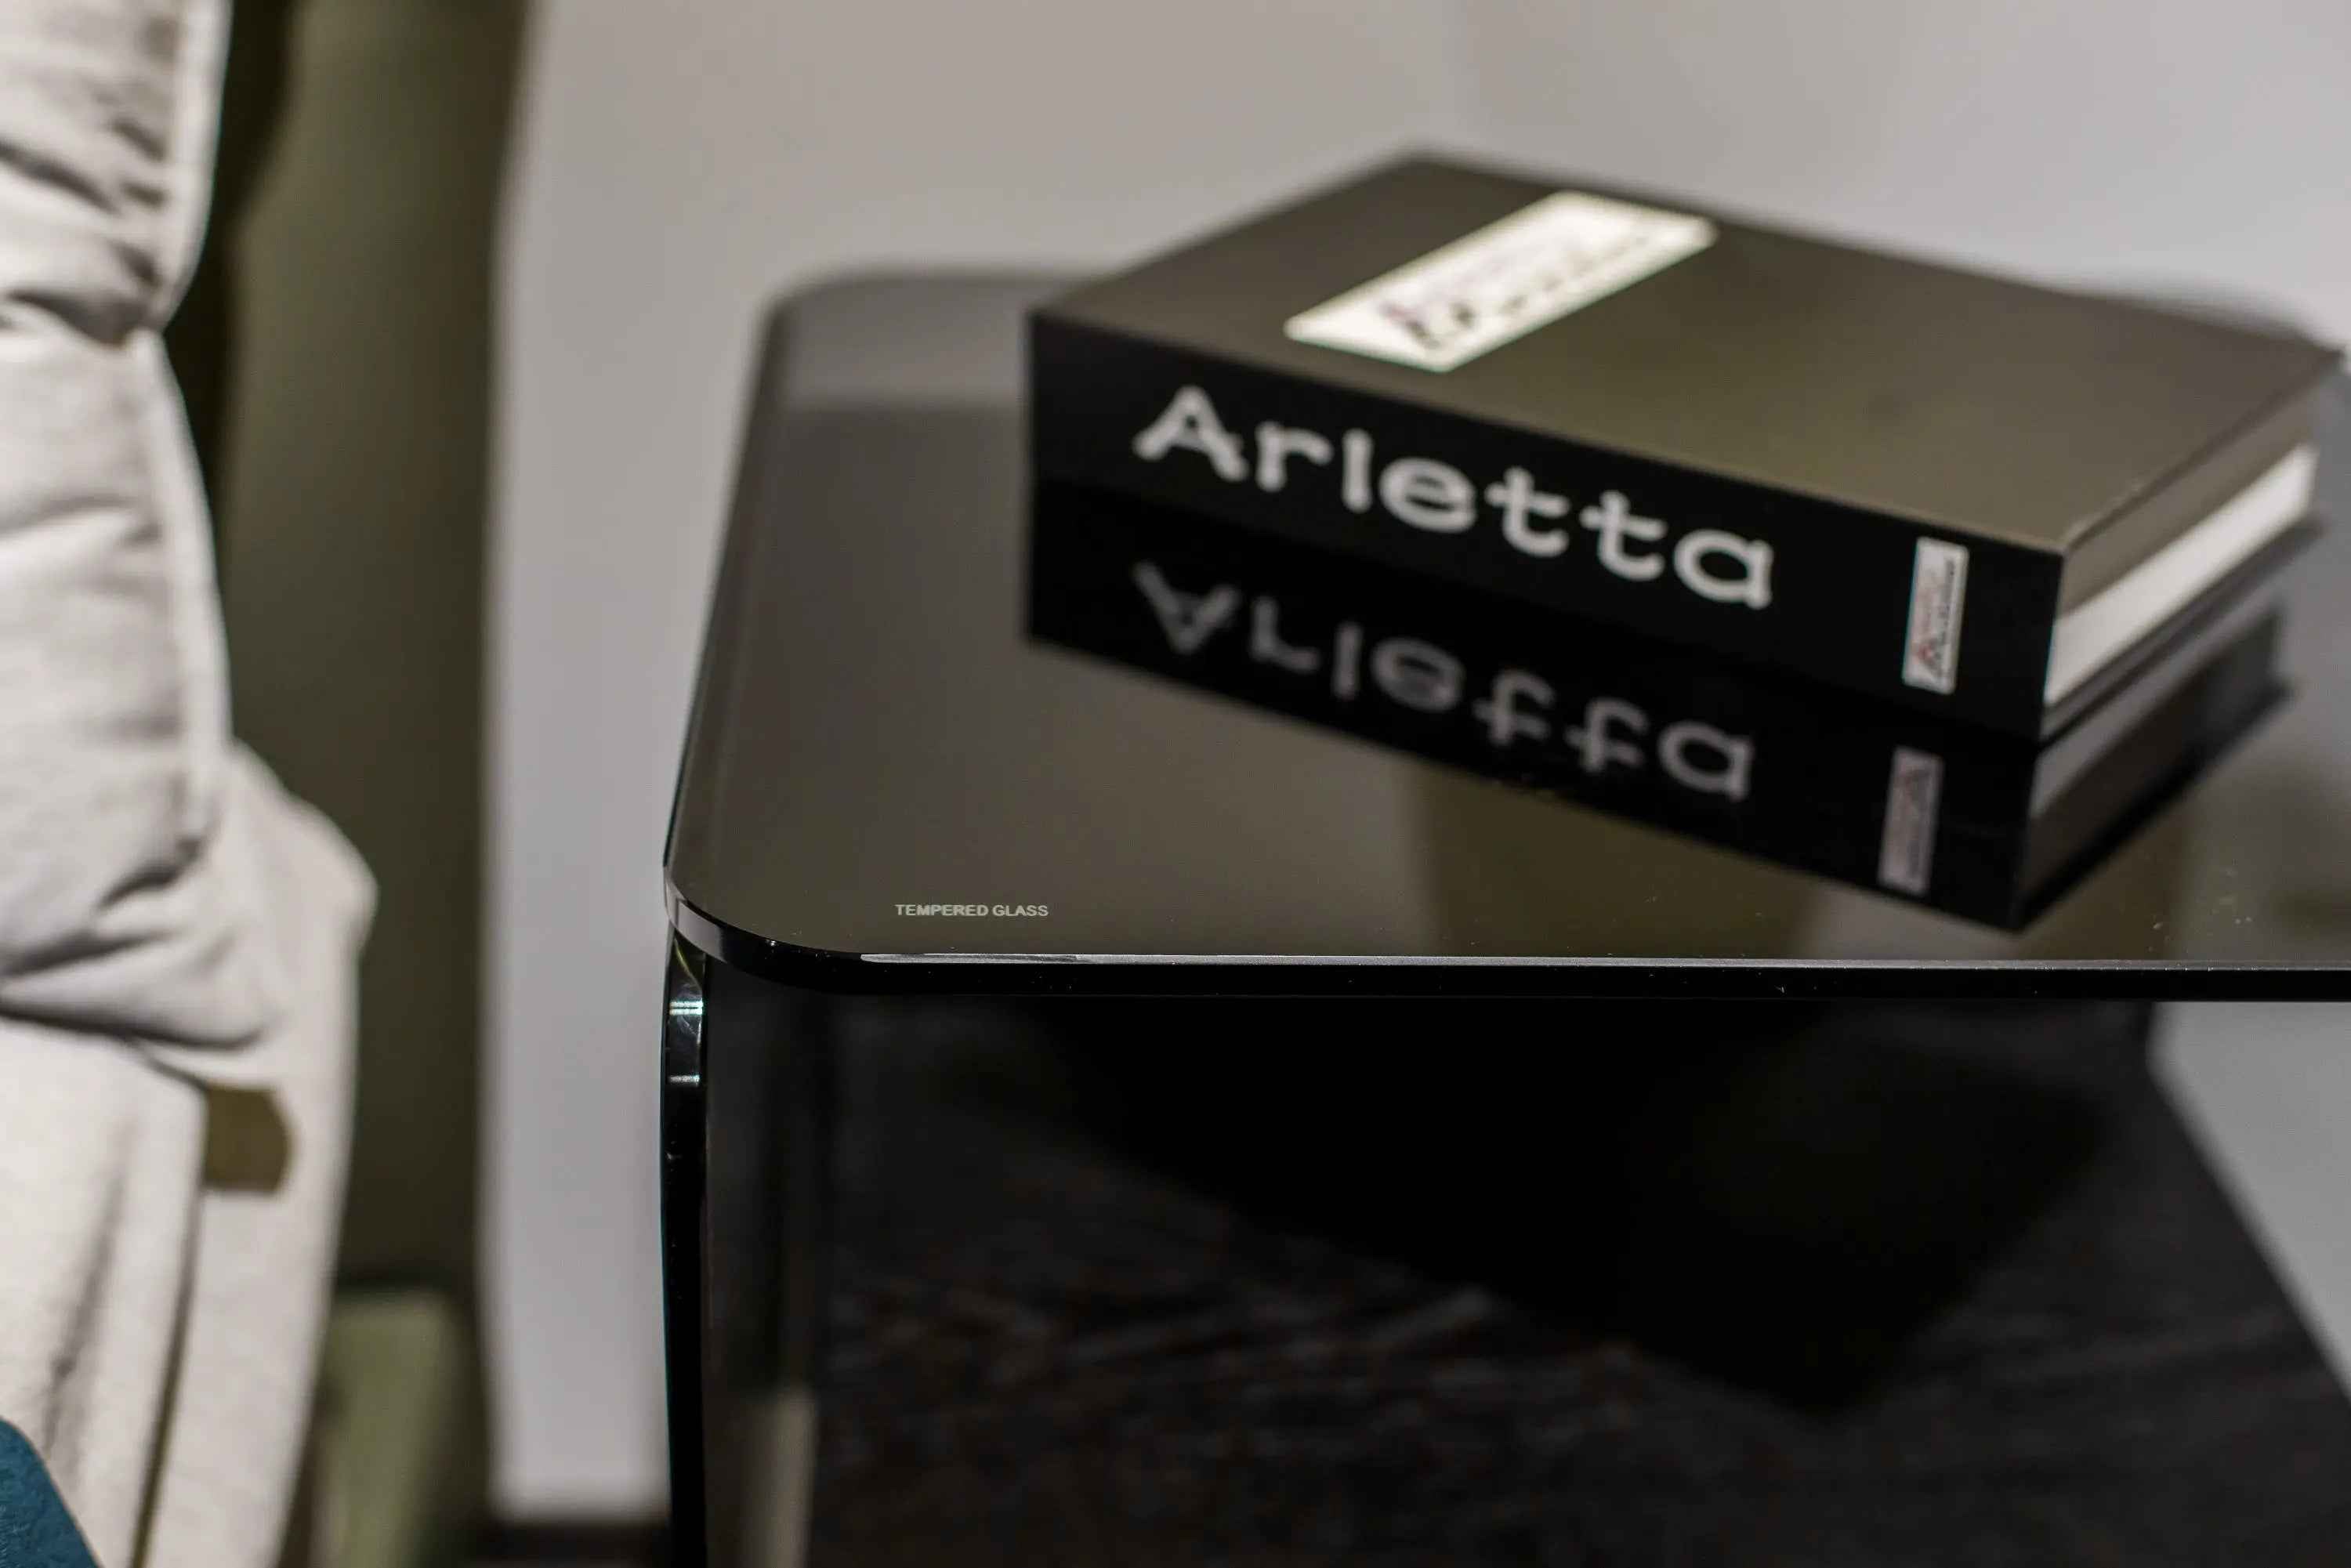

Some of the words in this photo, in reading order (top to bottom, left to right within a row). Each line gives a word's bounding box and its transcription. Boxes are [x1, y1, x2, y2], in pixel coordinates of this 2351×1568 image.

[1134, 386, 1773, 609] Arletta
[894, 904, 989, 916] TEMPERED
[991, 904, 1049, 917] GLASS
